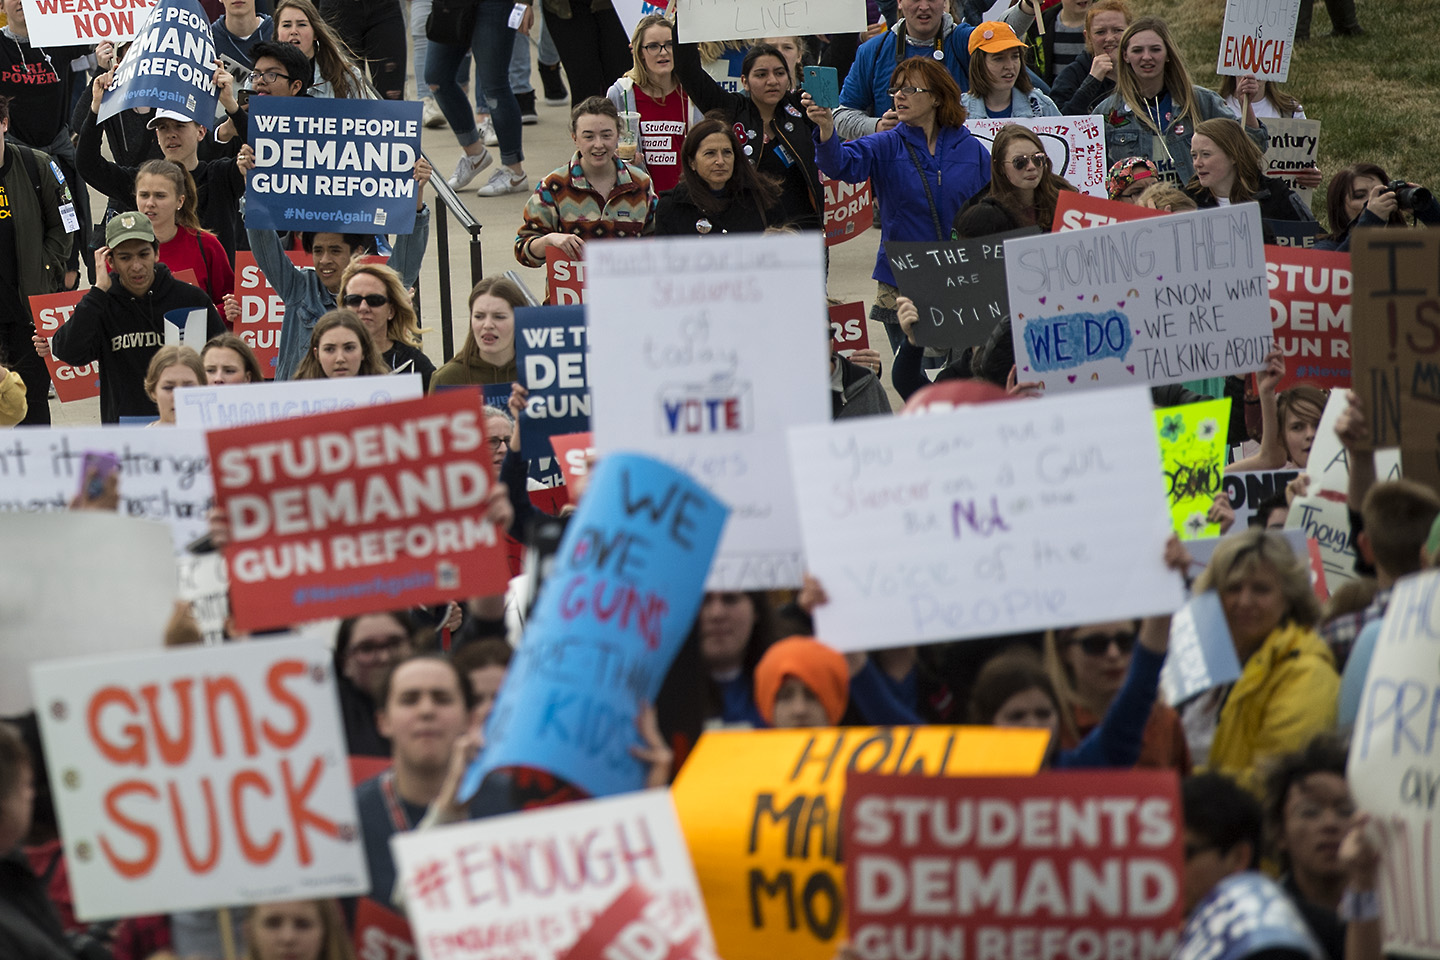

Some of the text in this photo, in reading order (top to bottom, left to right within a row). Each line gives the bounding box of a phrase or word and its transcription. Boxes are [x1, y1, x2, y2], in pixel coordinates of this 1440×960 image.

[72, 11, 136, 39] NOW
[735, 0, 809, 33] LIVE!
[1224, 35, 1285, 75] ENOUGH
[1, 70, 58, 85] POWER
[107, 57, 217, 98] GUN REFORM
[254, 115, 418, 138] WE THE PEOPLE
[644, 122, 683, 133] Students
[1054, 125, 1070, 136] 17
[254, 138, 417, 173] DEMAND
[647, 152, 676, 163] Action
[251, 172, 415, 199] GUN REFORM
[283, 207, 373, 225] #NeverAgain
[891, 247, 970, 273] WE THE
[1016, 211, 1254, 294] SHOWING THEM
[945, 272, 980, 288] ARE
[1153, 278, 1213, 309] KNOW
[522, 327, 565, 349] WE
[1144, 304, 1228, 340] WE ARE
[1029, 315, 1127, 366] WE DO
[1138, 334, 1274, 381] TALKING ABOUT
[526, 394, 592, 420] GUN
[663, 397, 742, 434] VOTE
[219, 410, 483, 492] STUDENTS
[226, 461, 492, 540] DEMAND
[618, 465, 707, 551] WE
[234, 516, 499, 584] GUN REFORM
[85, 657, 312, 769] GUNS
[98, 756, 340, 881] SUCK
[853, 795, 1176, 851] STUDENTS
[411, 814, 664, 912] #ENOUGH
[859, 855, 1179, 918] DEMAND
[859, 922, 1183, 960] GUN REFORM
